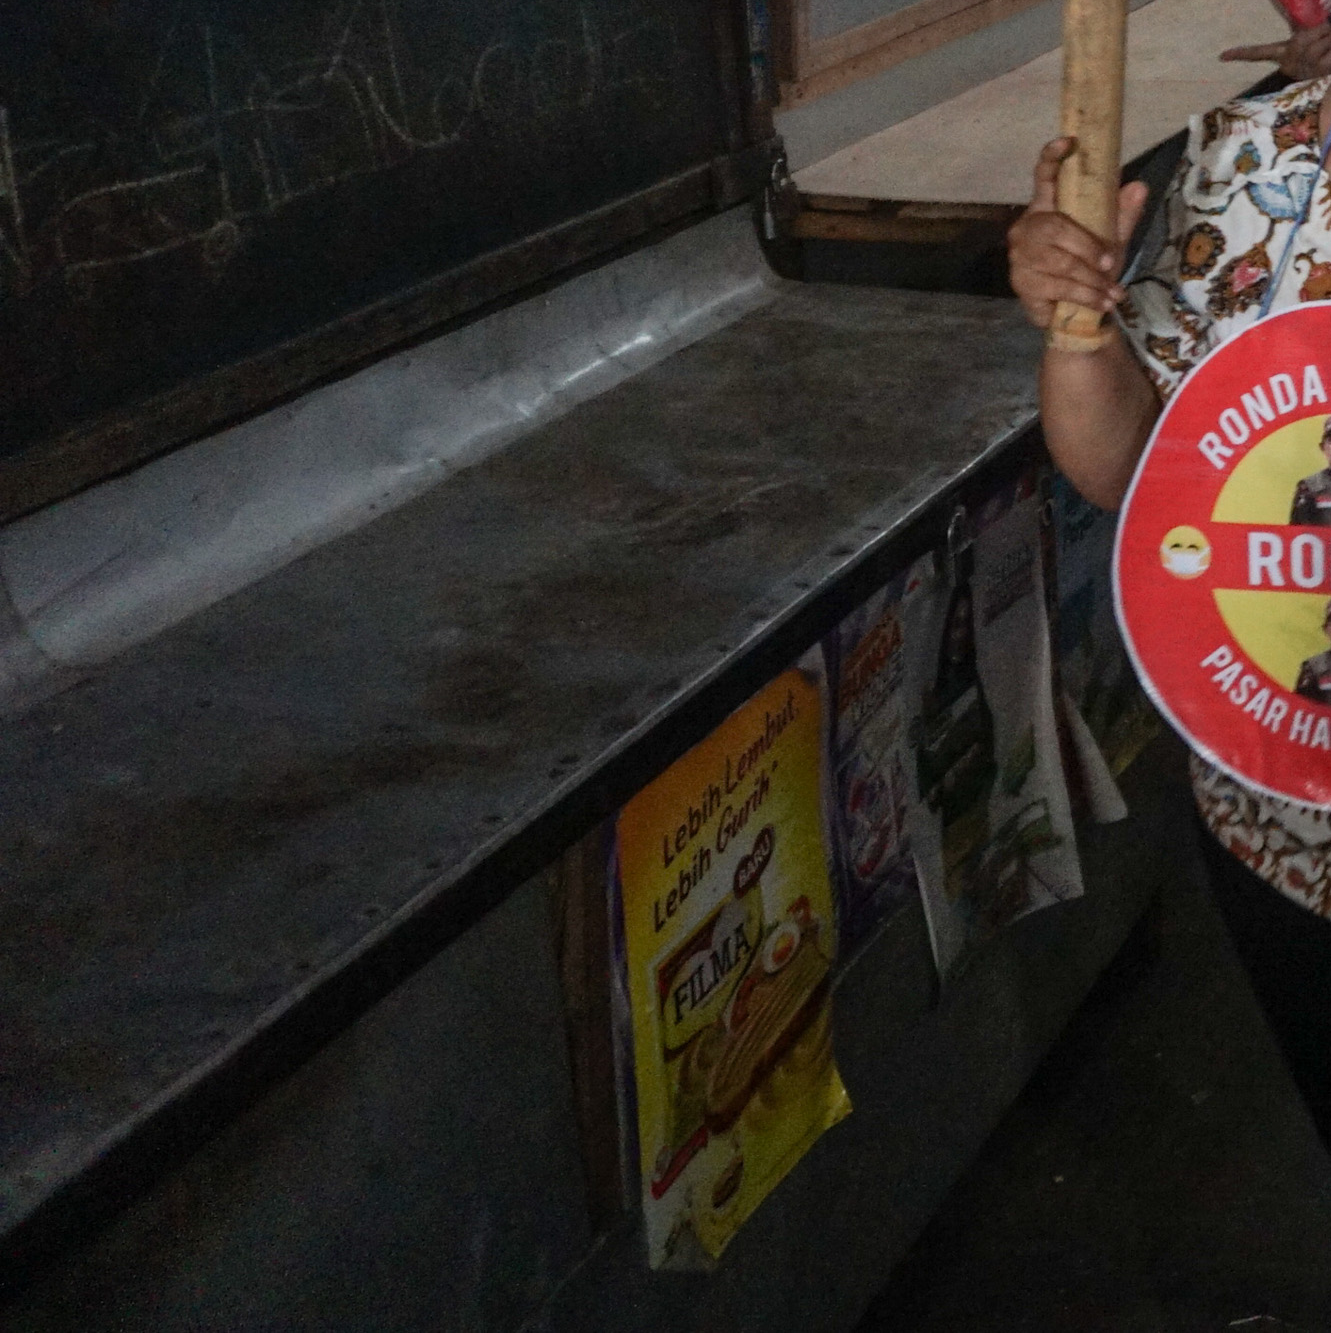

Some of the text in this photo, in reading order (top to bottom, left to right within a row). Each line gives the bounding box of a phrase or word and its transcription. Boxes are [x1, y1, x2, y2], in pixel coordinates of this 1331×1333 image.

[1197, 363, 1328, 470] RONDA
[1201, 644, 1286, 736] PASAR
[662, 783, 721, 869] Lebih
[653, 849, 712, 934] Lebih
[673, 922, 752, 1024] FILMA
